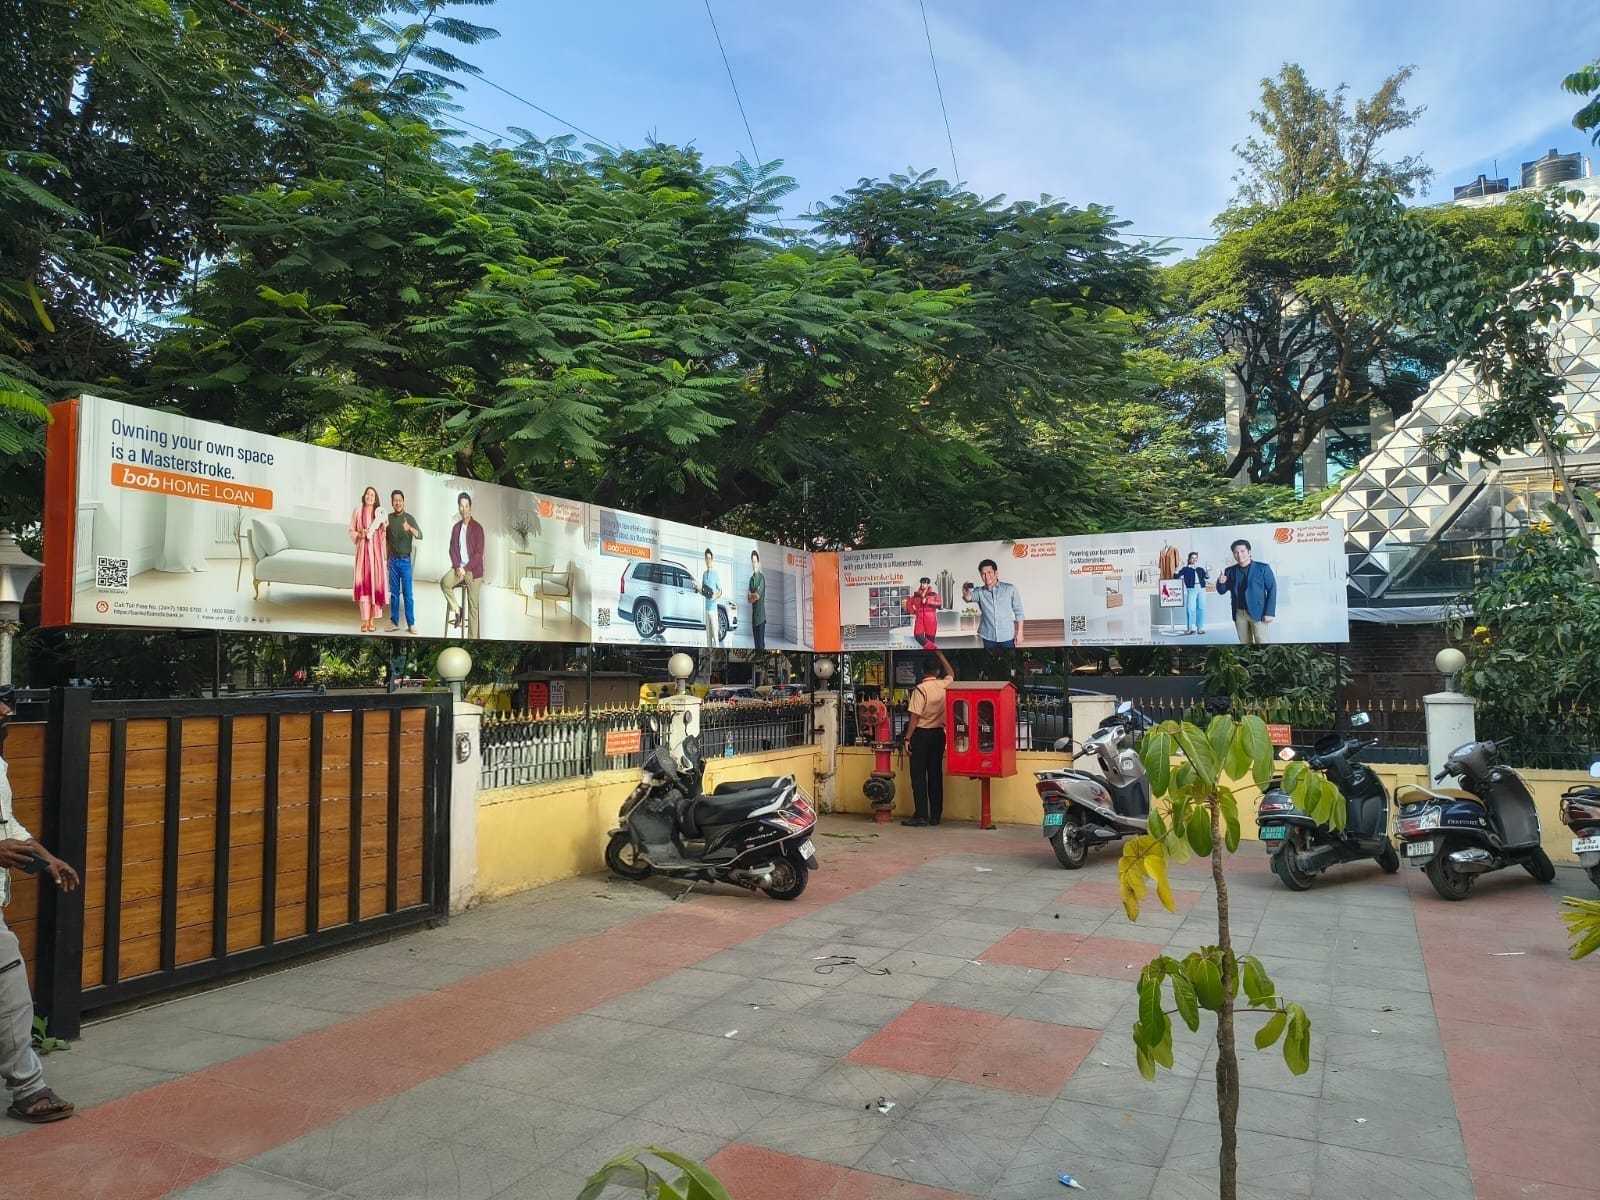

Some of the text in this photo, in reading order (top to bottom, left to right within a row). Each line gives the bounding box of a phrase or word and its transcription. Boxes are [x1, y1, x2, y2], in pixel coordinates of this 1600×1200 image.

[112, 419, 274, 465] Owning your own space
[112, 442, 234, 479] is a Masterstroke.
[122, 469, 255, 503] bob HOME LOAN
